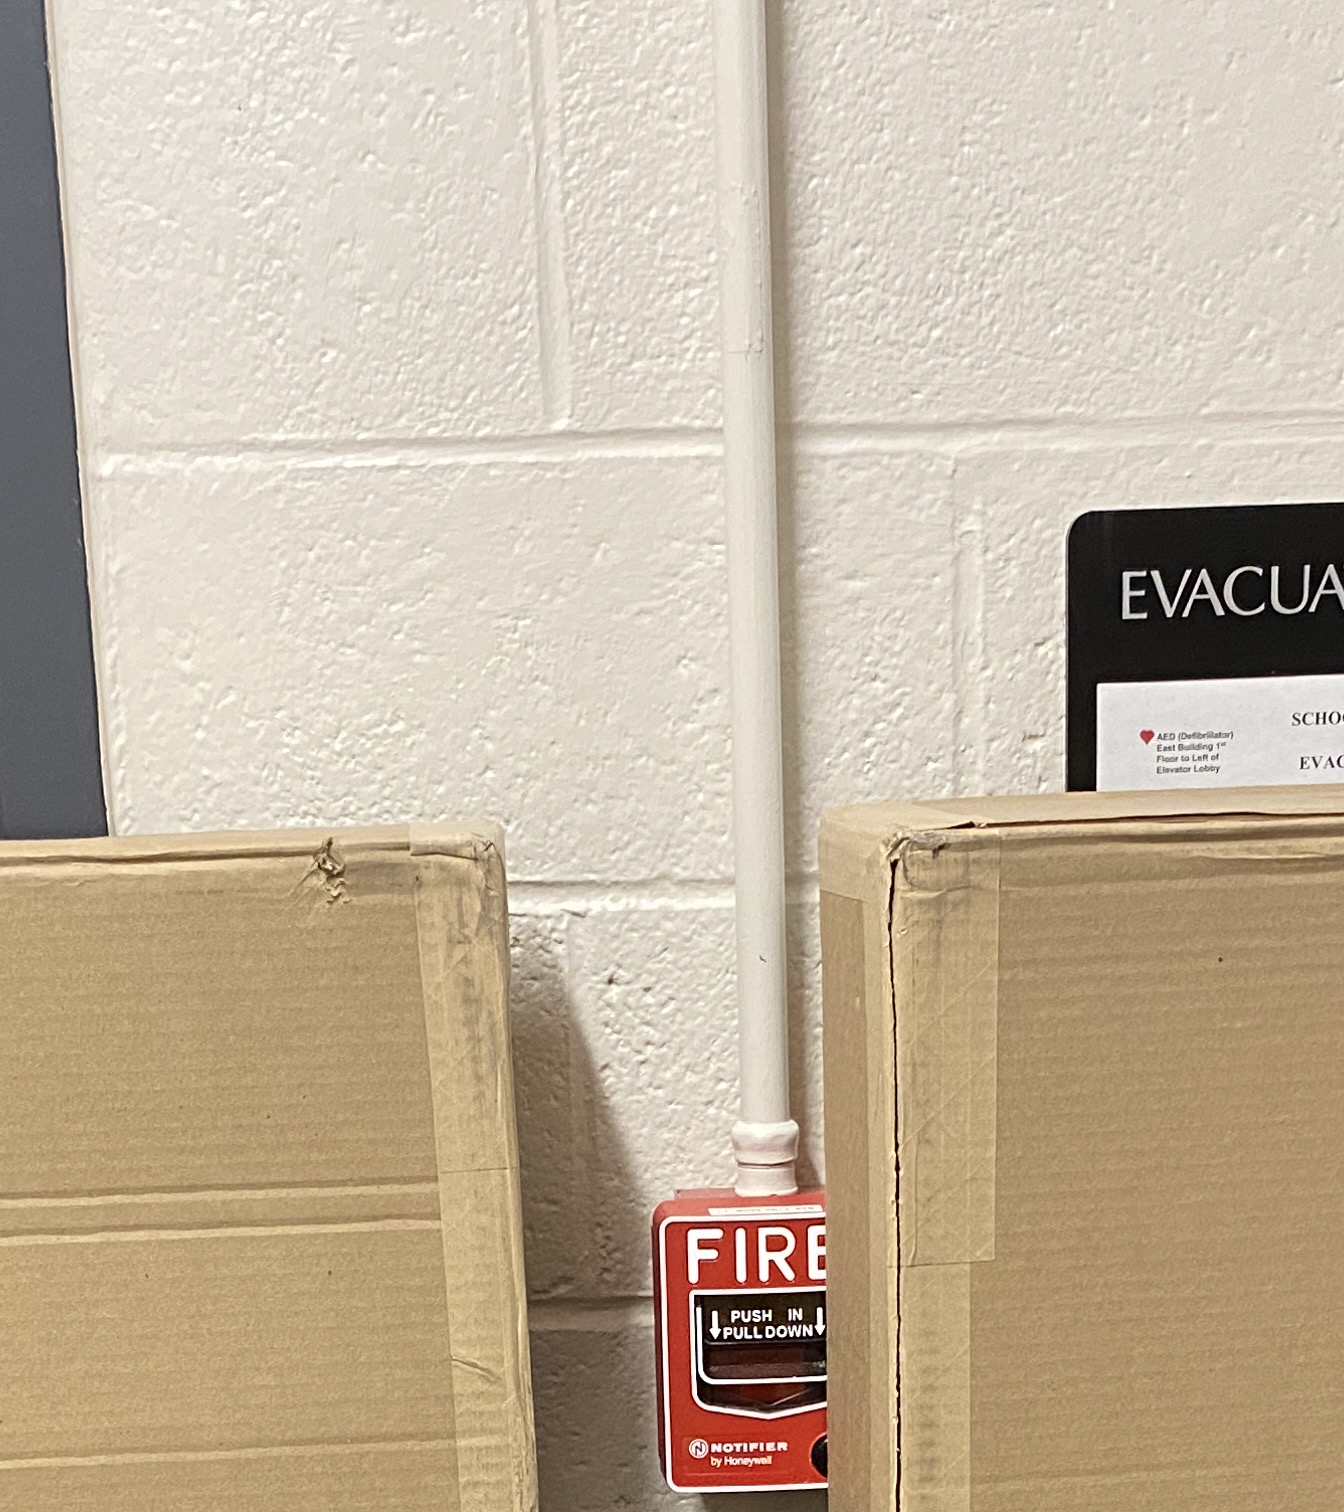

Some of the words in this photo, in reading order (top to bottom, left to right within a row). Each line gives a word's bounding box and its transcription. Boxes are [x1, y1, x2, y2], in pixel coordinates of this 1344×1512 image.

[1157, 732, 1176, 741] AED
[1156, 744, 1176, 752] East
[1178, 743, 1214, 752] Building
[1156, 755, 1178, 763] Floor
[1211, 753, 1220, 761] of
[1156, 765, 1191, 774] Elevator
[1194, 764, 1221, 773] Lobby
[686, 1224, 827, 1285] FIRE
[730, 1309, 772, 1323] PUSH
[788, 1307, 803, 1321] IN
[723, 1326, 763, 1339] PULL
[765, 1324, 814, 1338] DOWN
[710, 1441, 788, 1453] NOTIFIER
[710, 1456, 721, 1468] by
[724, 1455, 772, 1467] Honeywell
